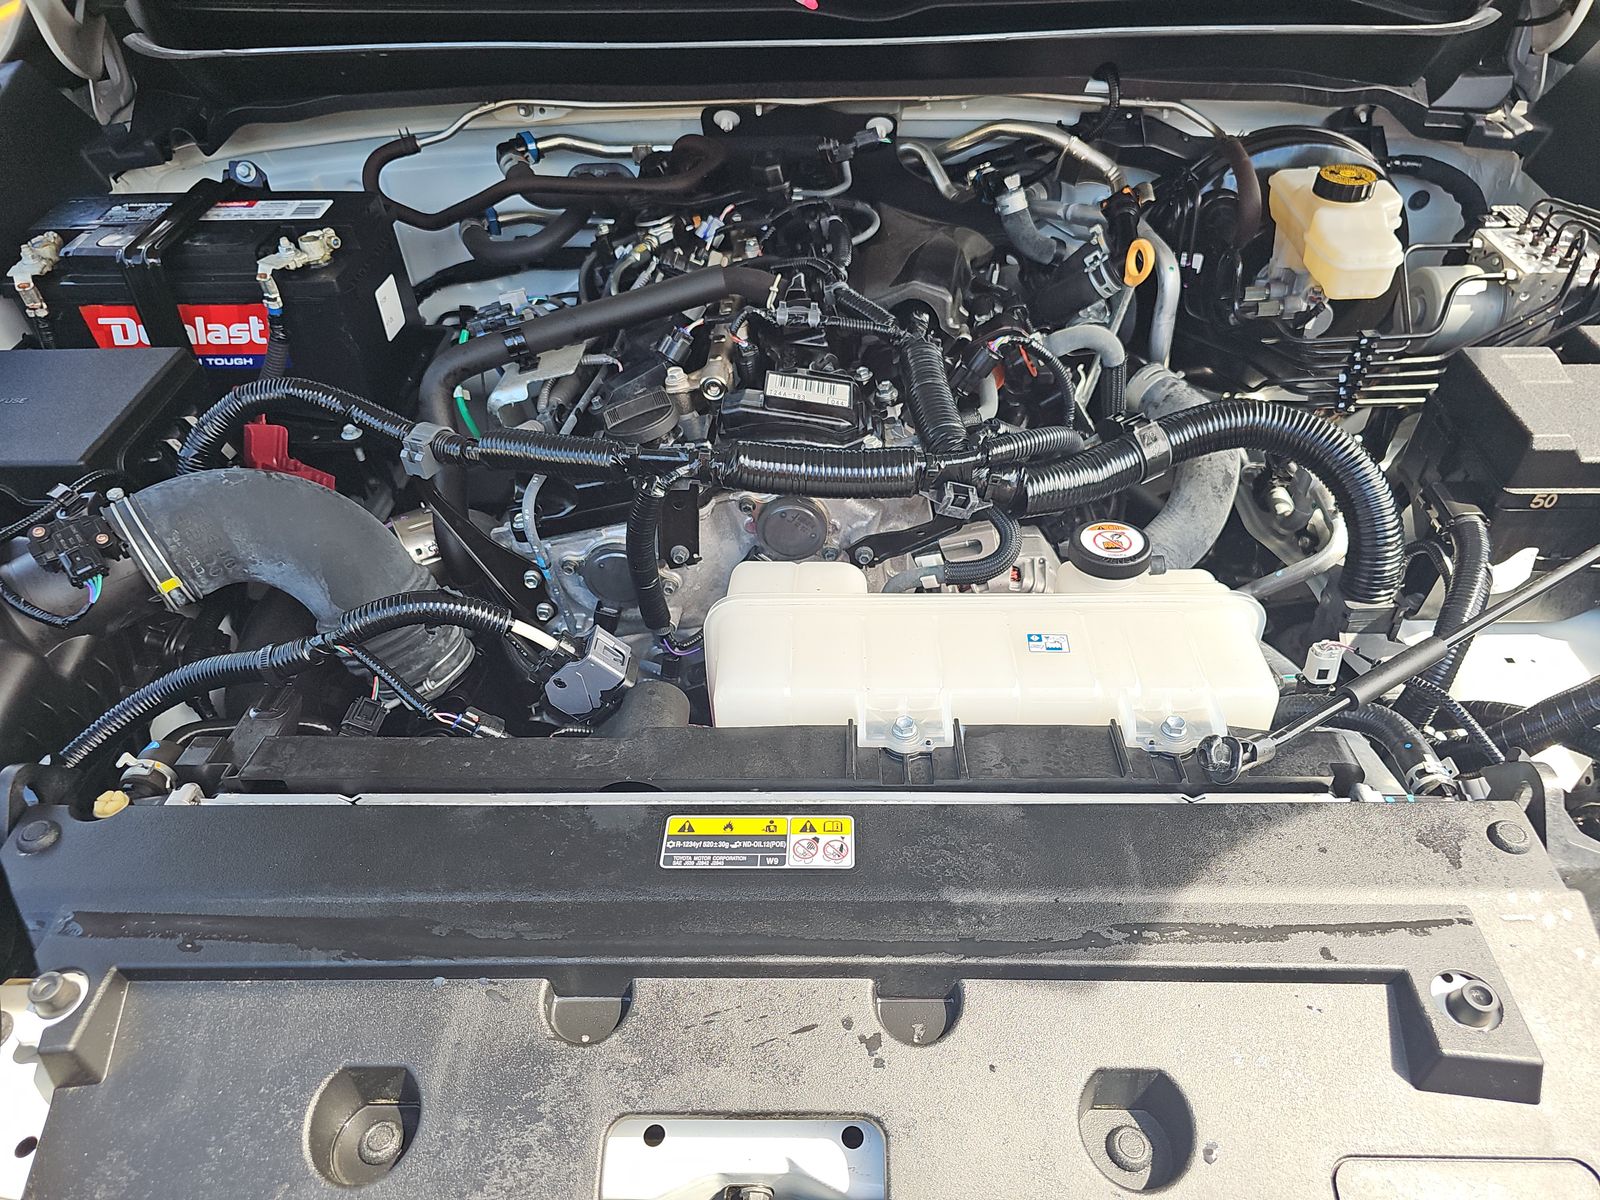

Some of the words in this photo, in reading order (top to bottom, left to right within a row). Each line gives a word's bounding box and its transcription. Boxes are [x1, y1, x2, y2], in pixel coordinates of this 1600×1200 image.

[98, 316, 267, 345] Dlast
[206, 357, 253, 366] TOUGH
[1530, 494, 1559, 509] 50
[766, 857, 779, 865] W9
